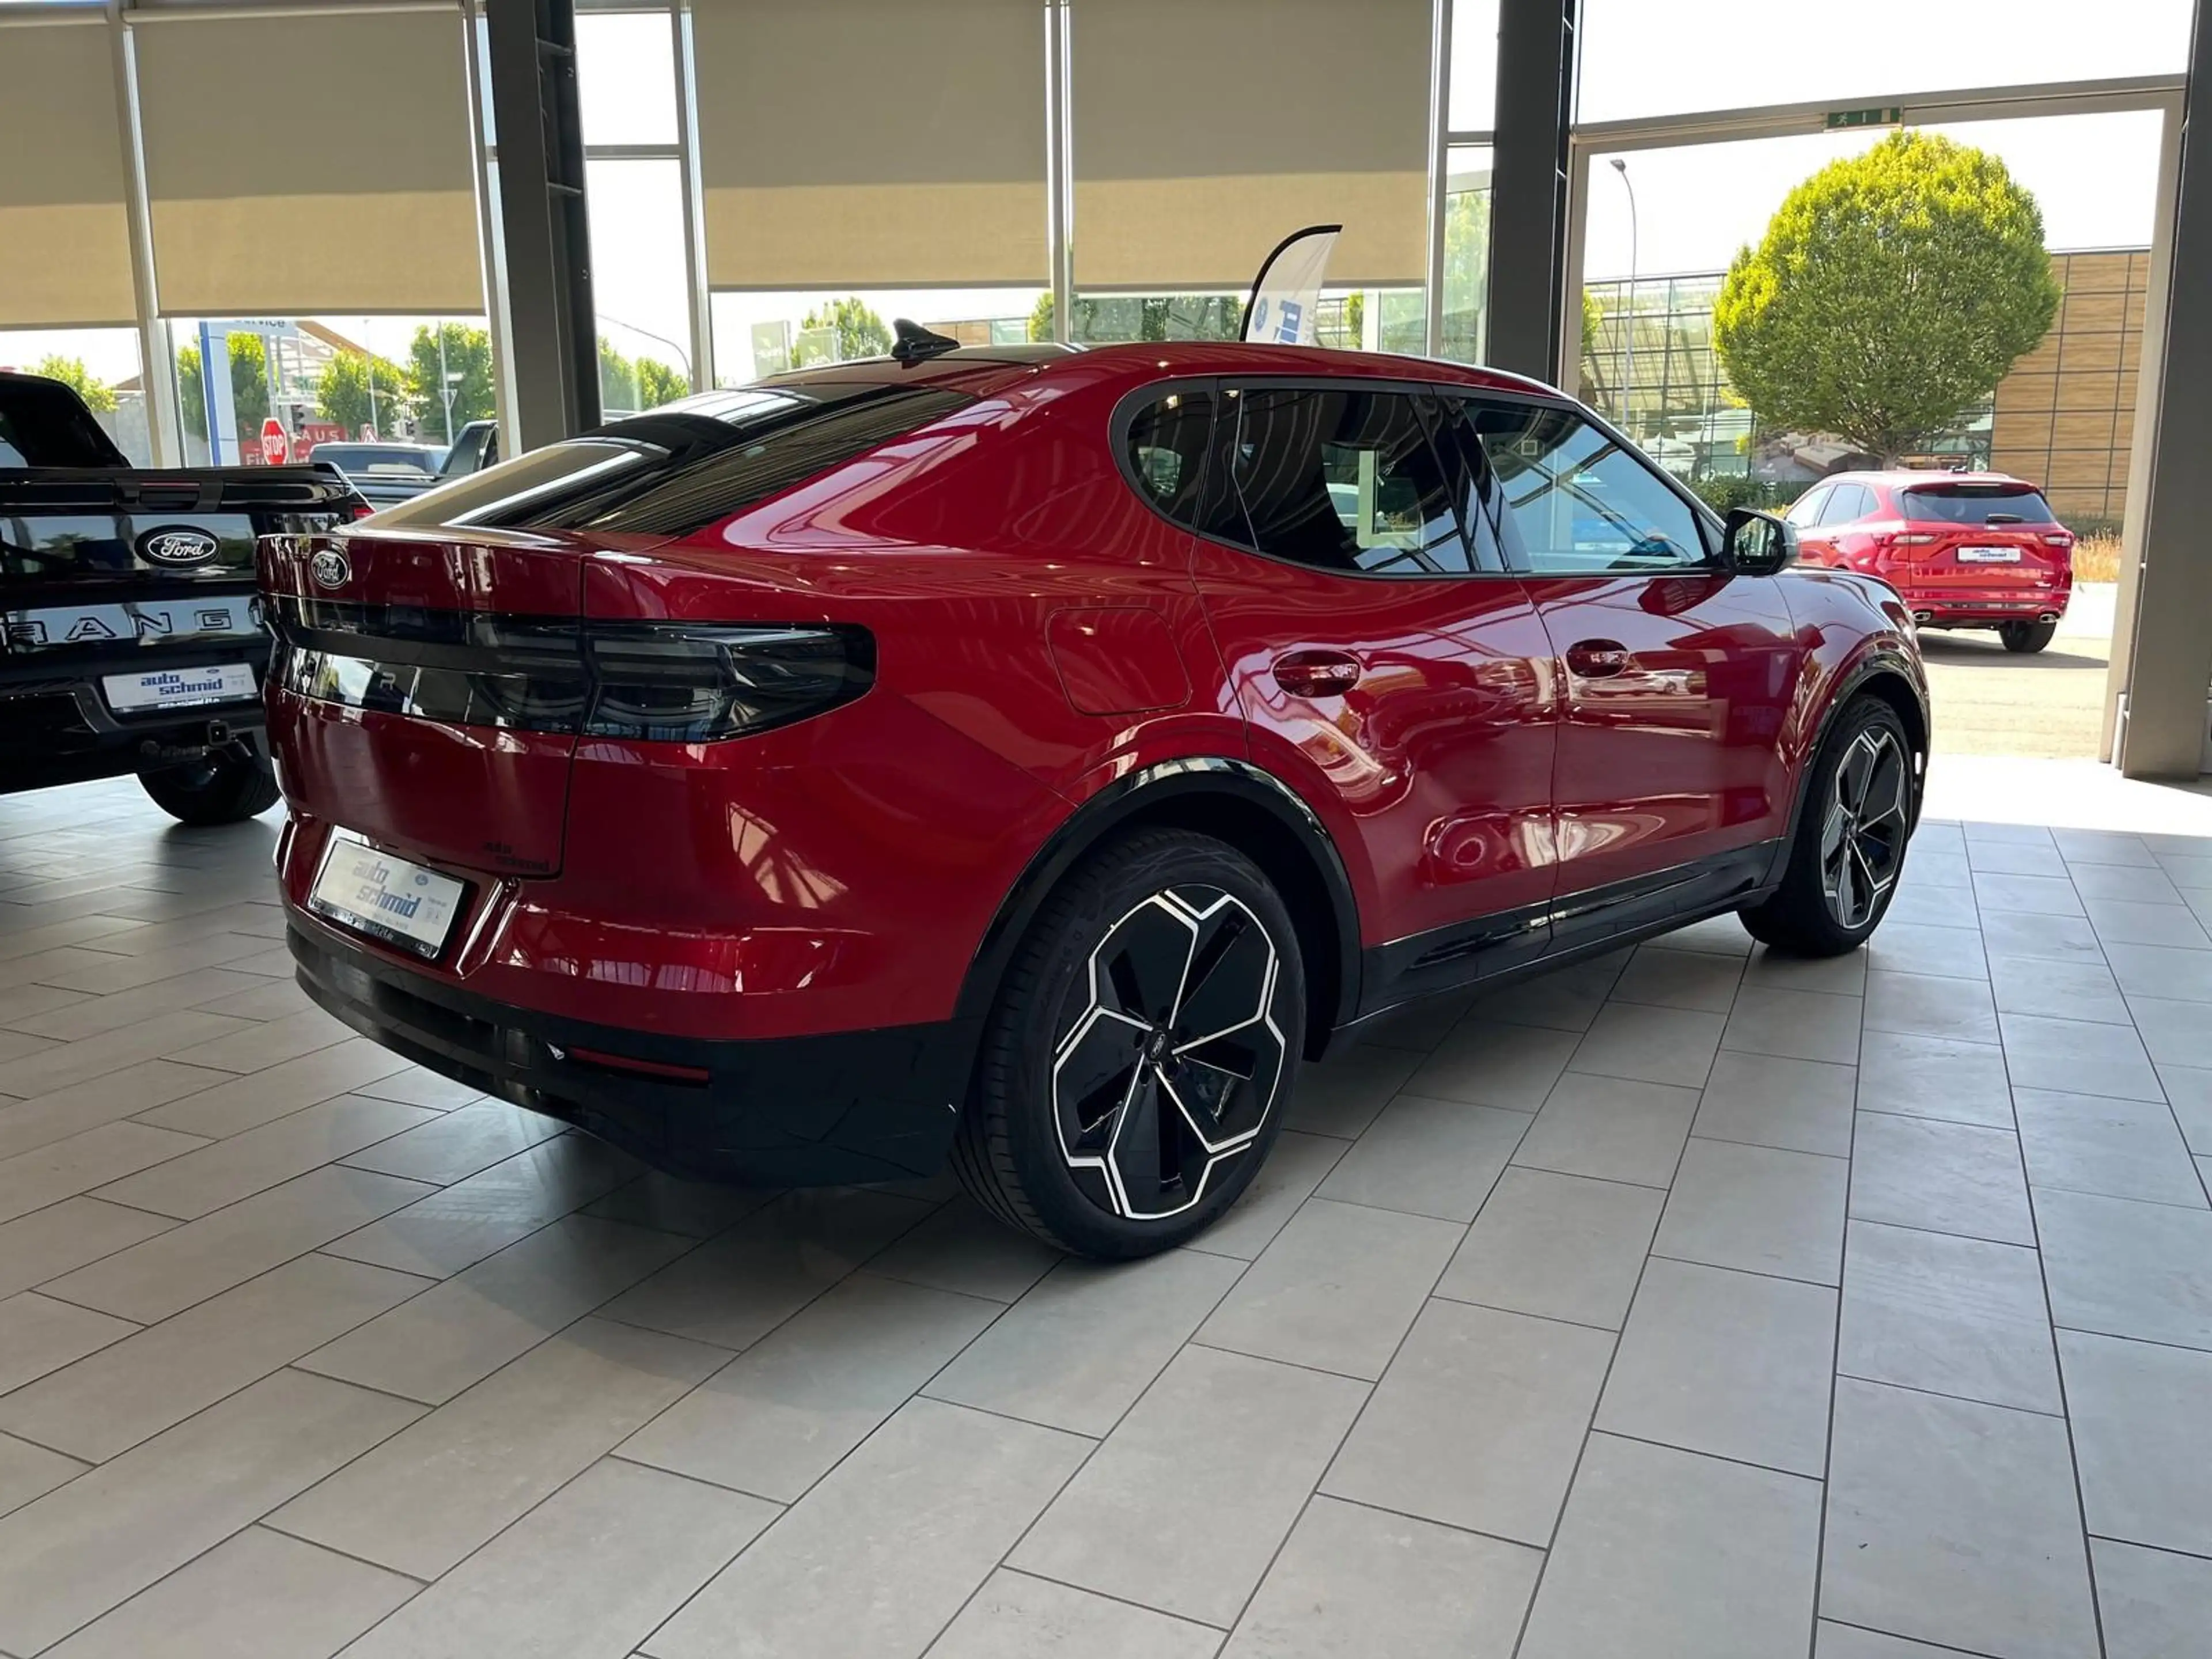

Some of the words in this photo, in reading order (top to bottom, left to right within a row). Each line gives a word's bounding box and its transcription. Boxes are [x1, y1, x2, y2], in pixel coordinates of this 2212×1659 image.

[264, 436, 284, 456] STOP
[160, 537, 205, 557] Ford
[141, 673, 180, 687] auto
[159, 678, 222, 695] schmid
[353, 861, 390, 884] auto
[355, 885, 422, 919] schmid
